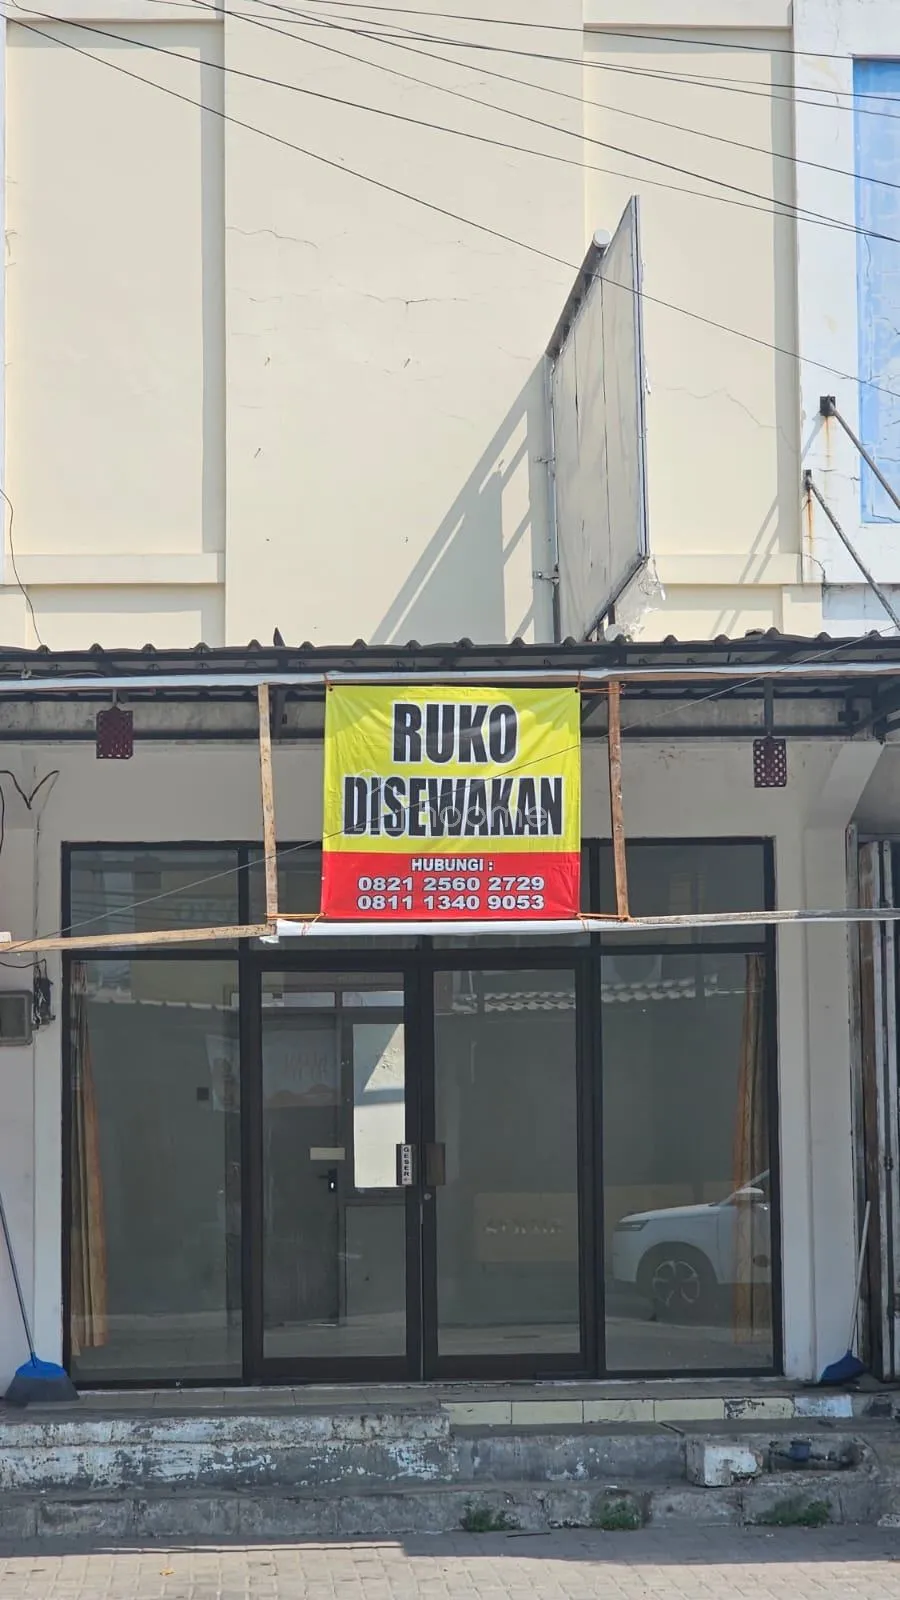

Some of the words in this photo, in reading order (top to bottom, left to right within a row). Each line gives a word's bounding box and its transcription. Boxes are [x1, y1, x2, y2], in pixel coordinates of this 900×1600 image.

[393, 702, 517, 763] RUKO
[343, 776, 562, 837] DISEWAKAN
[411, 858, 484, 871] HUBUNGI
[358, 876, 413, 891] 0821
[423, 876, 481, 891] 2560
[487, 876, 545, 891] 2729
[357, 895, 413, 910] 0811
[423, 895, 481, 910] 1340
[487, 895, 545, 910] 9053
